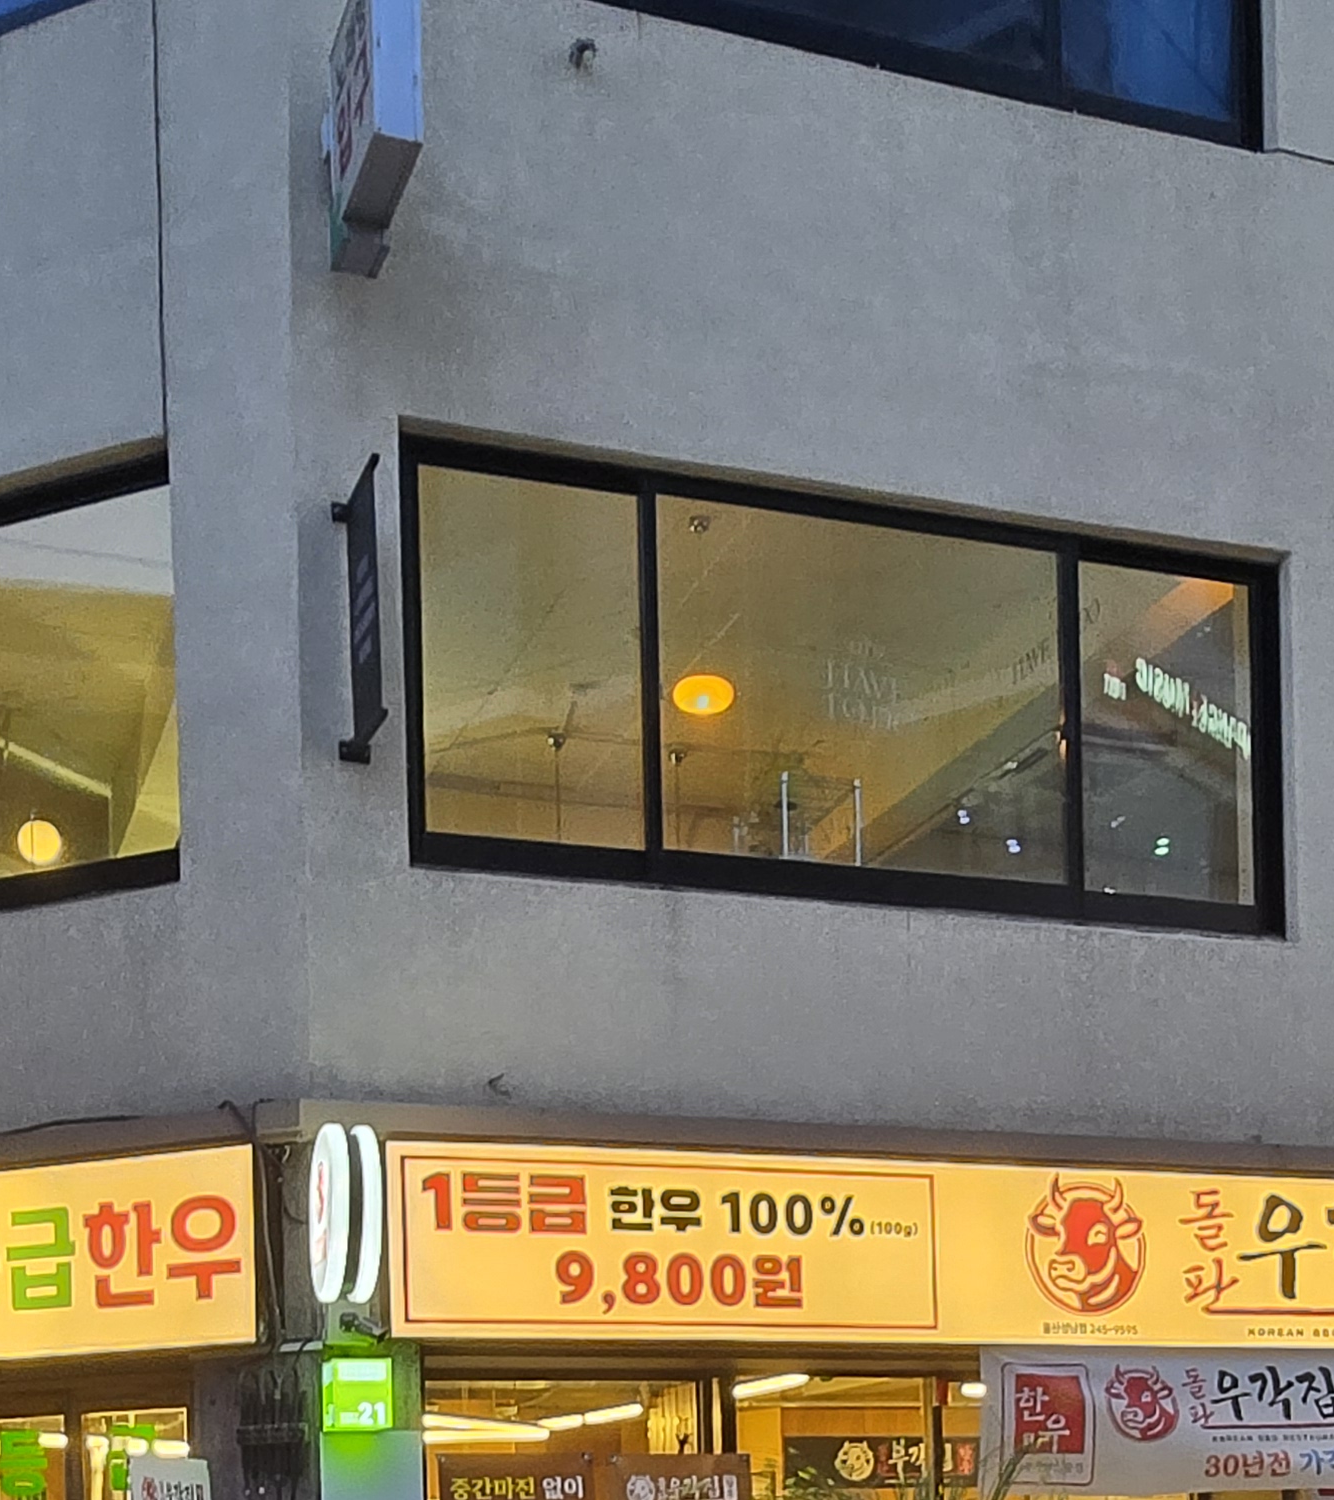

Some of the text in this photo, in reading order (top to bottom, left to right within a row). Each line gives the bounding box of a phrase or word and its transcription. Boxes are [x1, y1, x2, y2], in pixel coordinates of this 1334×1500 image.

[419, 1170, 920, 1239] 1등급 한우 100% (100g)
[1178, 1189, 1240, 1314] 돌판
[554, 1249, 805, 1315] 9,800원
[1089, 1322, 1139, 1336] 245-9595
[1247, 1326, 1305, 1339] KOREAN
[357, 1400, 386, 1426] 21
[1204, 1451, 1292, 1479] 30년전
[541, 1474, 585, 1500] 없이
